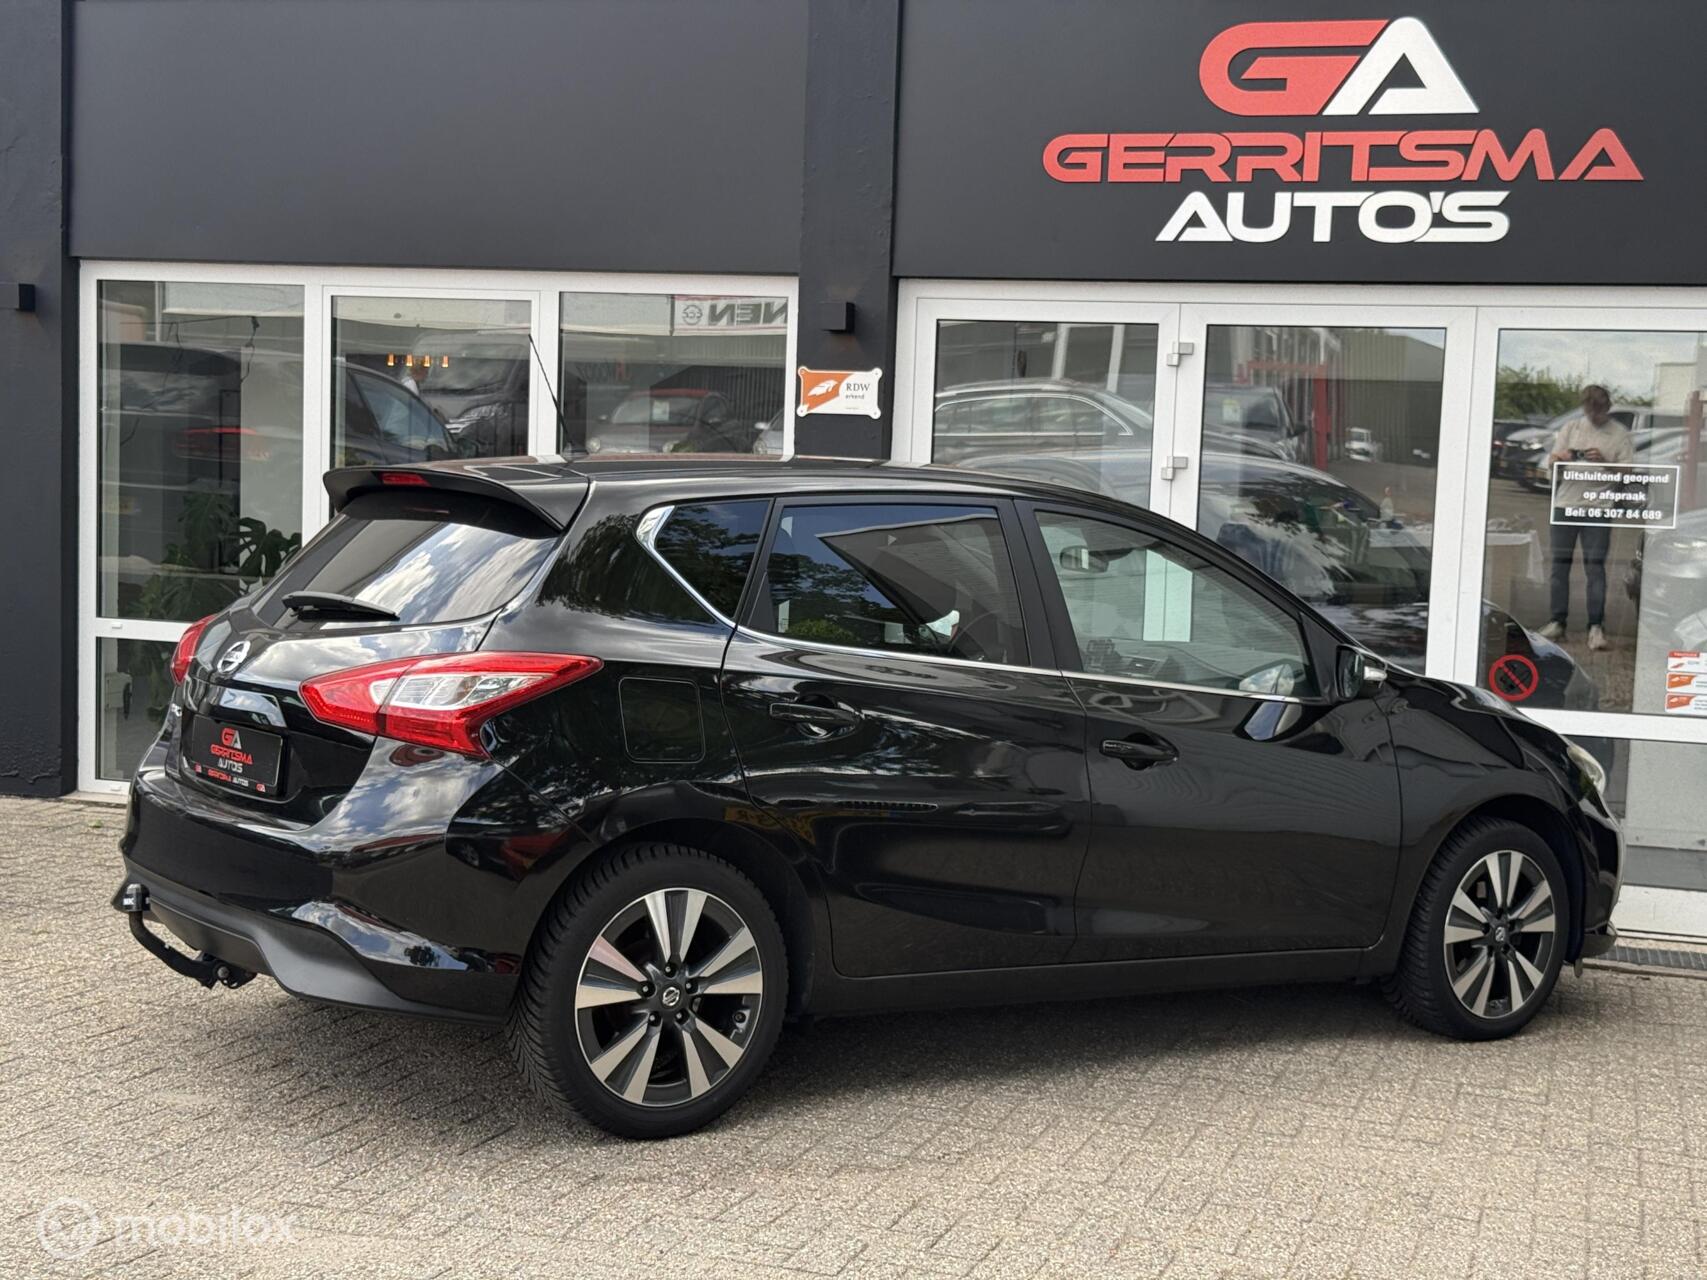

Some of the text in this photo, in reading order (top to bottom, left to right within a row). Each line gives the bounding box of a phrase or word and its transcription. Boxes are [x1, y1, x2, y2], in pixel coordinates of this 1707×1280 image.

[1199, 16, 1479, 117] GA
[1042, 127, 1645, 183] GERRITSMA
[1155, 189, 1511, 244] AUTO'S
[846, 382, 871, 392] RDW
[1563, 470, 1669, 484] Uitsluitend geopend
[1583, 490, 1646, 501] op afspraak
[1564, 507, 1586, 517] Bel:
[1588, 508, 1601, 518] 06
[1603, 508, 1624, 518] 307
[1642, 510, 1662, 520] 689
